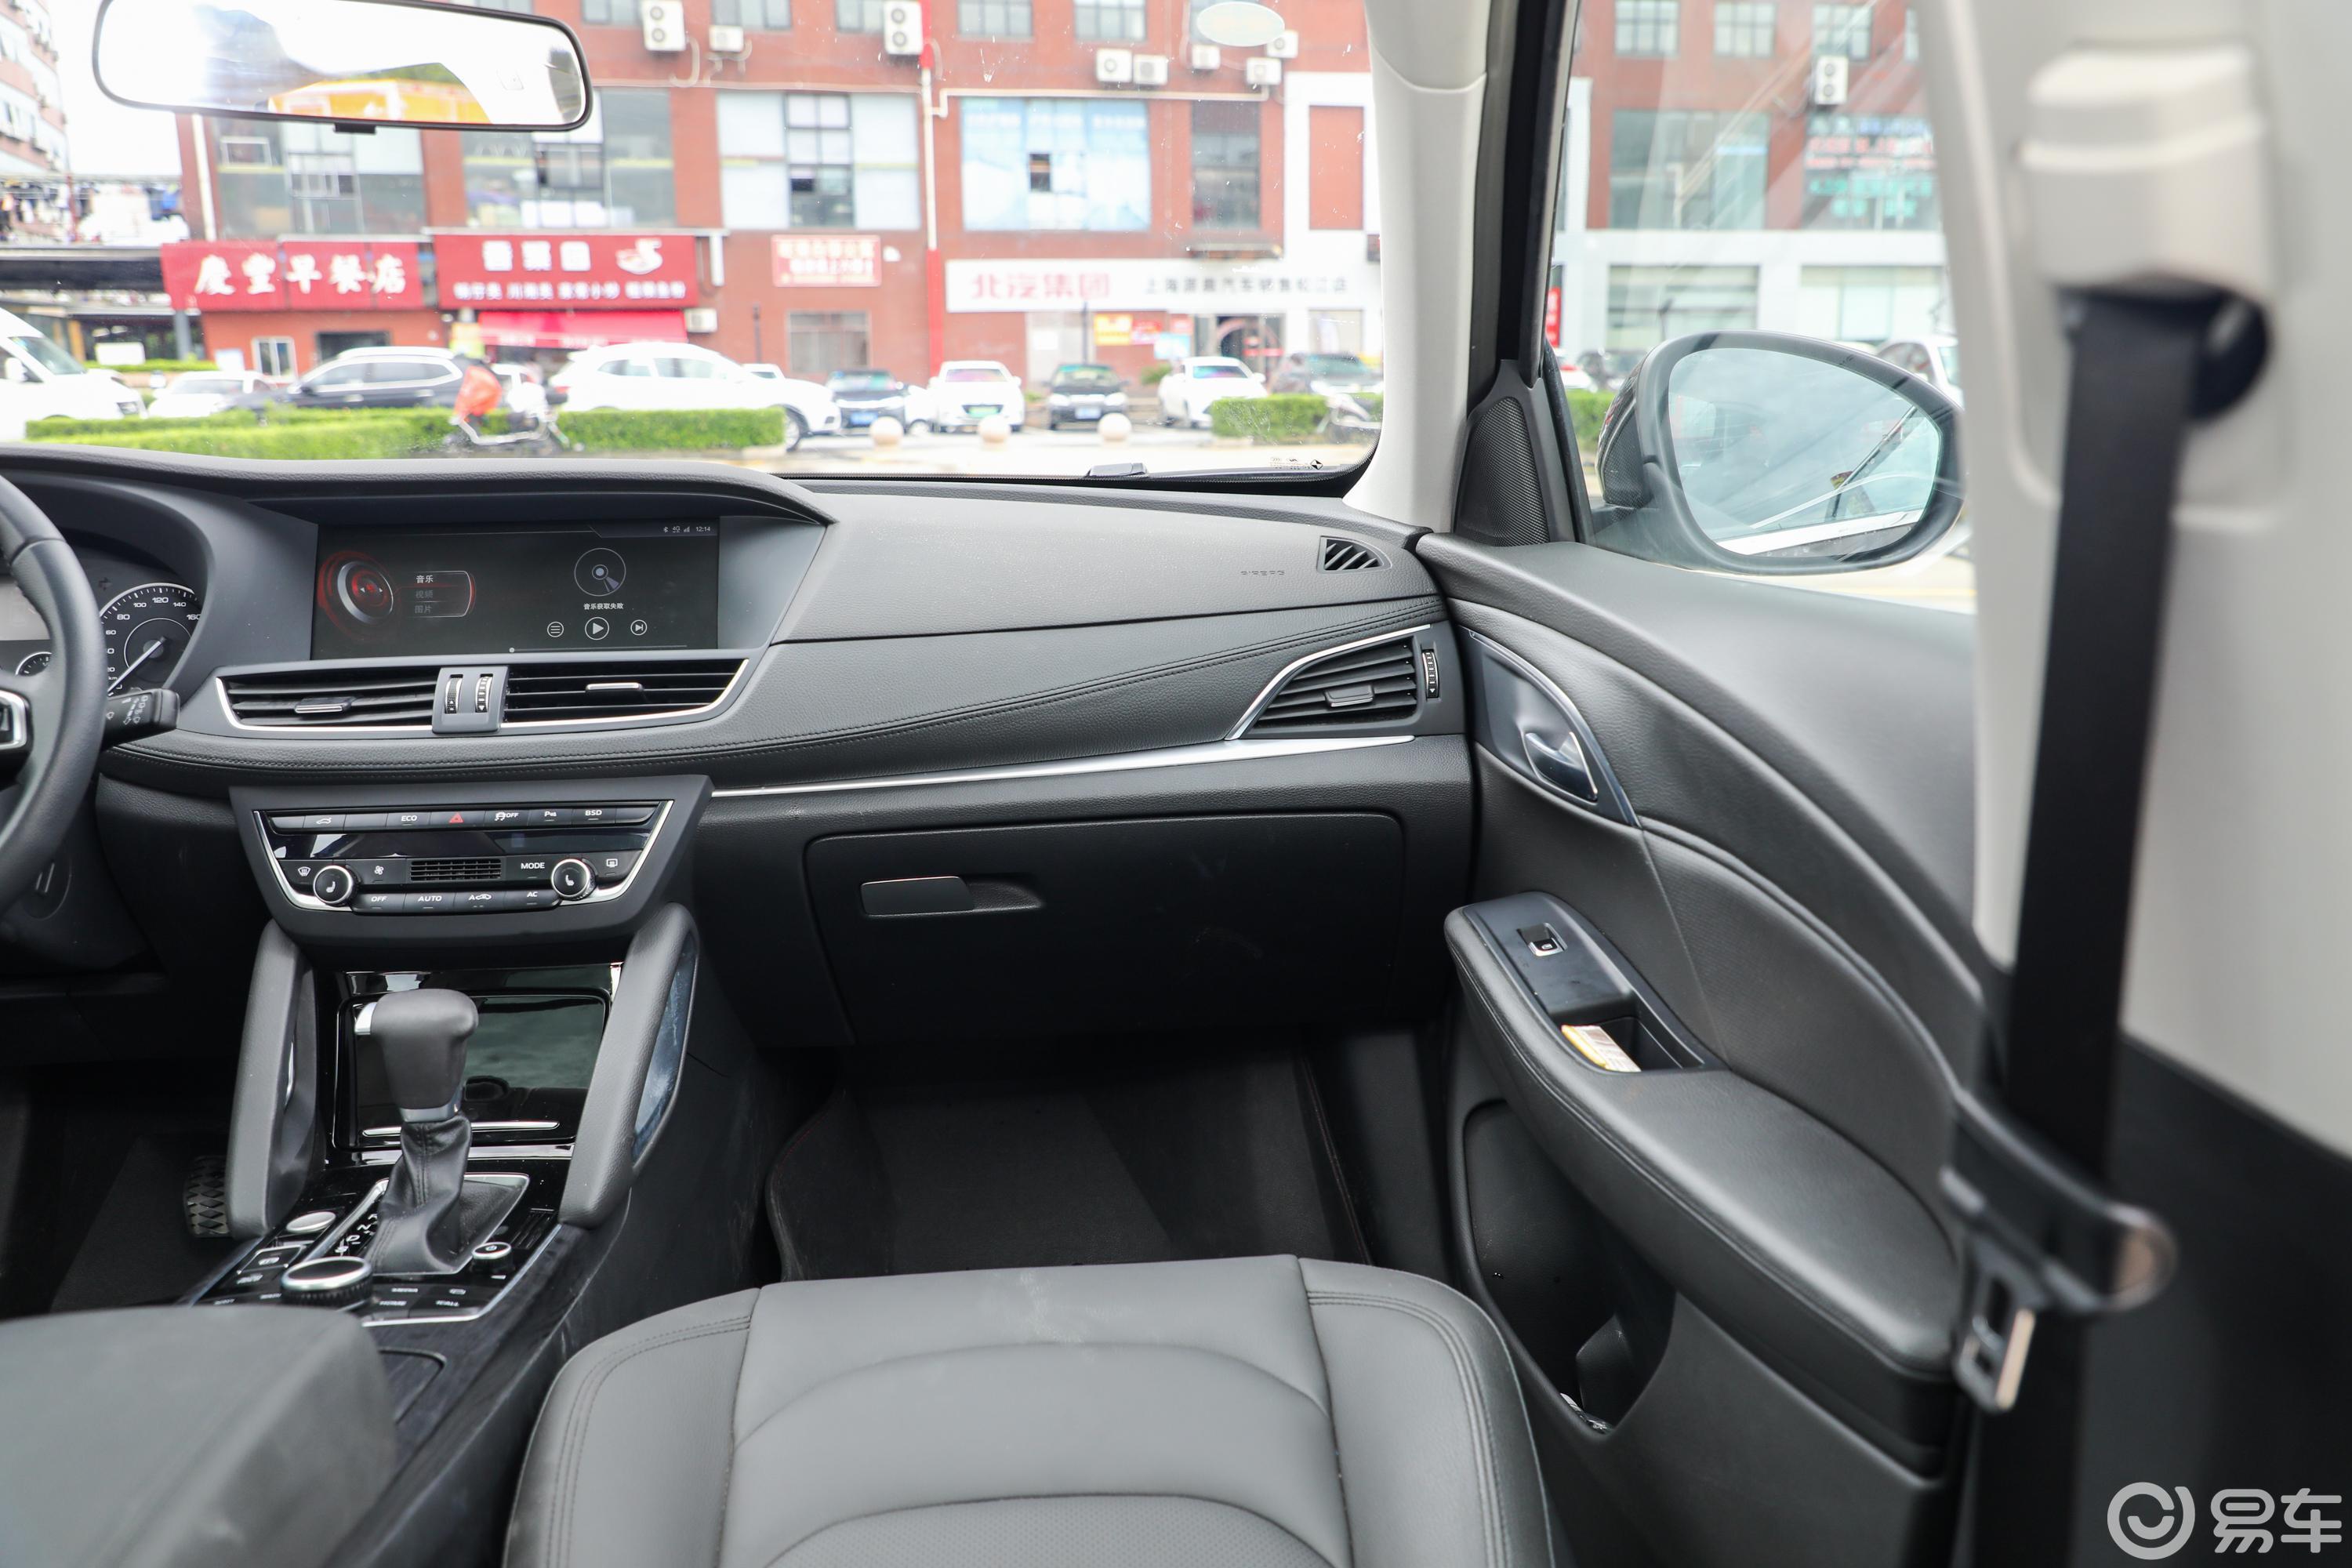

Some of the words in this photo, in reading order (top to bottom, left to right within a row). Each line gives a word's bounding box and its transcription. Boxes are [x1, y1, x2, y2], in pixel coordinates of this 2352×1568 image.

[416, 575, 434, 584] 音乐
[415, 590, 434, 599] 视频
[414, 604, 433, 614] 照片
[583, 602, 624, 611] 音乐获取失败
